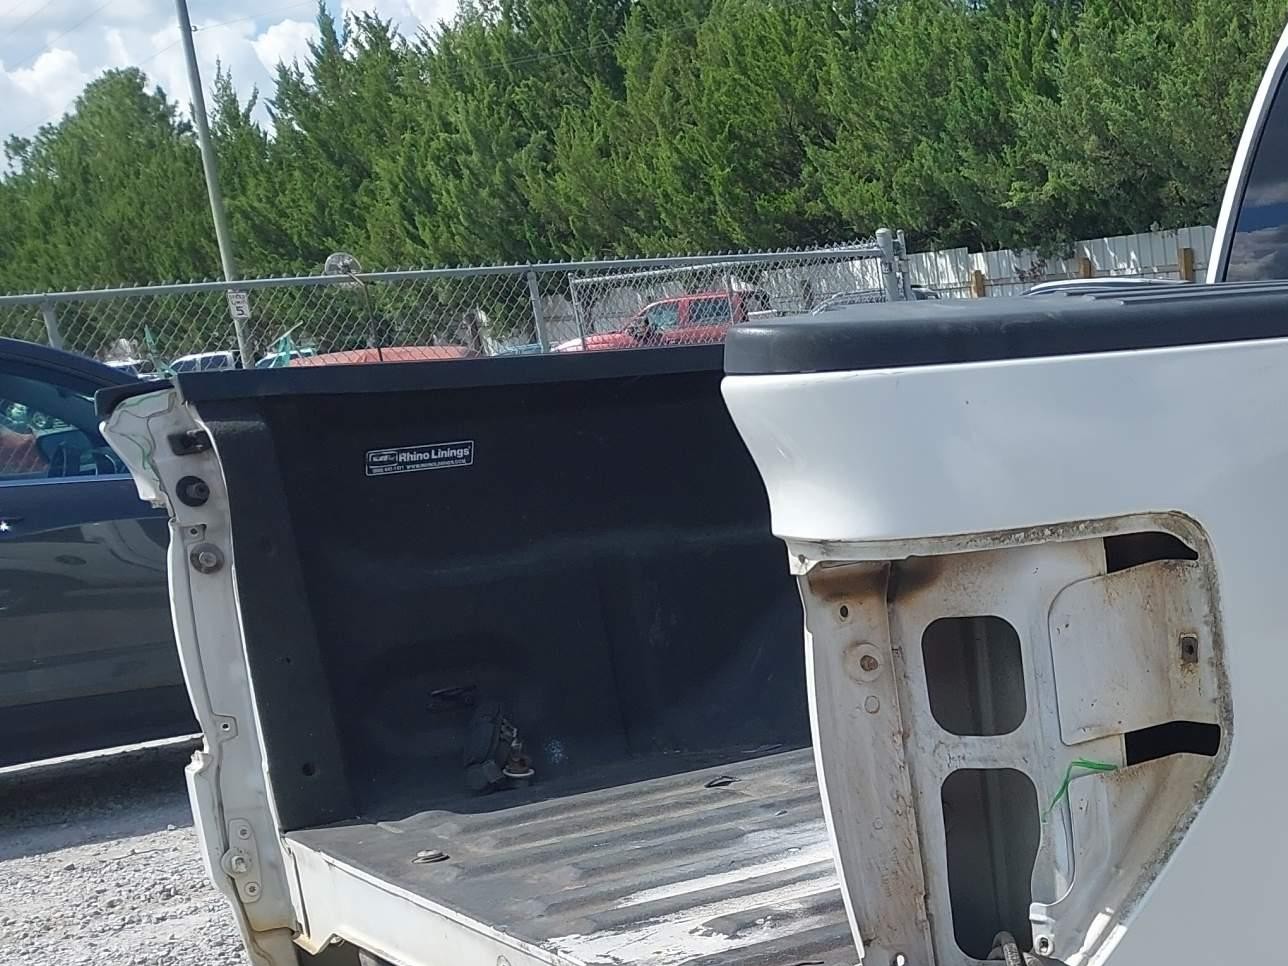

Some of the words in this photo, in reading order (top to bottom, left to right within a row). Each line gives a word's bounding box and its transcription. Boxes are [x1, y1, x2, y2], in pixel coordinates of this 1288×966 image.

[236, 306, 245, 316] 5
[398, 451, 430, 463] Rhino
[431, 447, 470, 460] Linings
